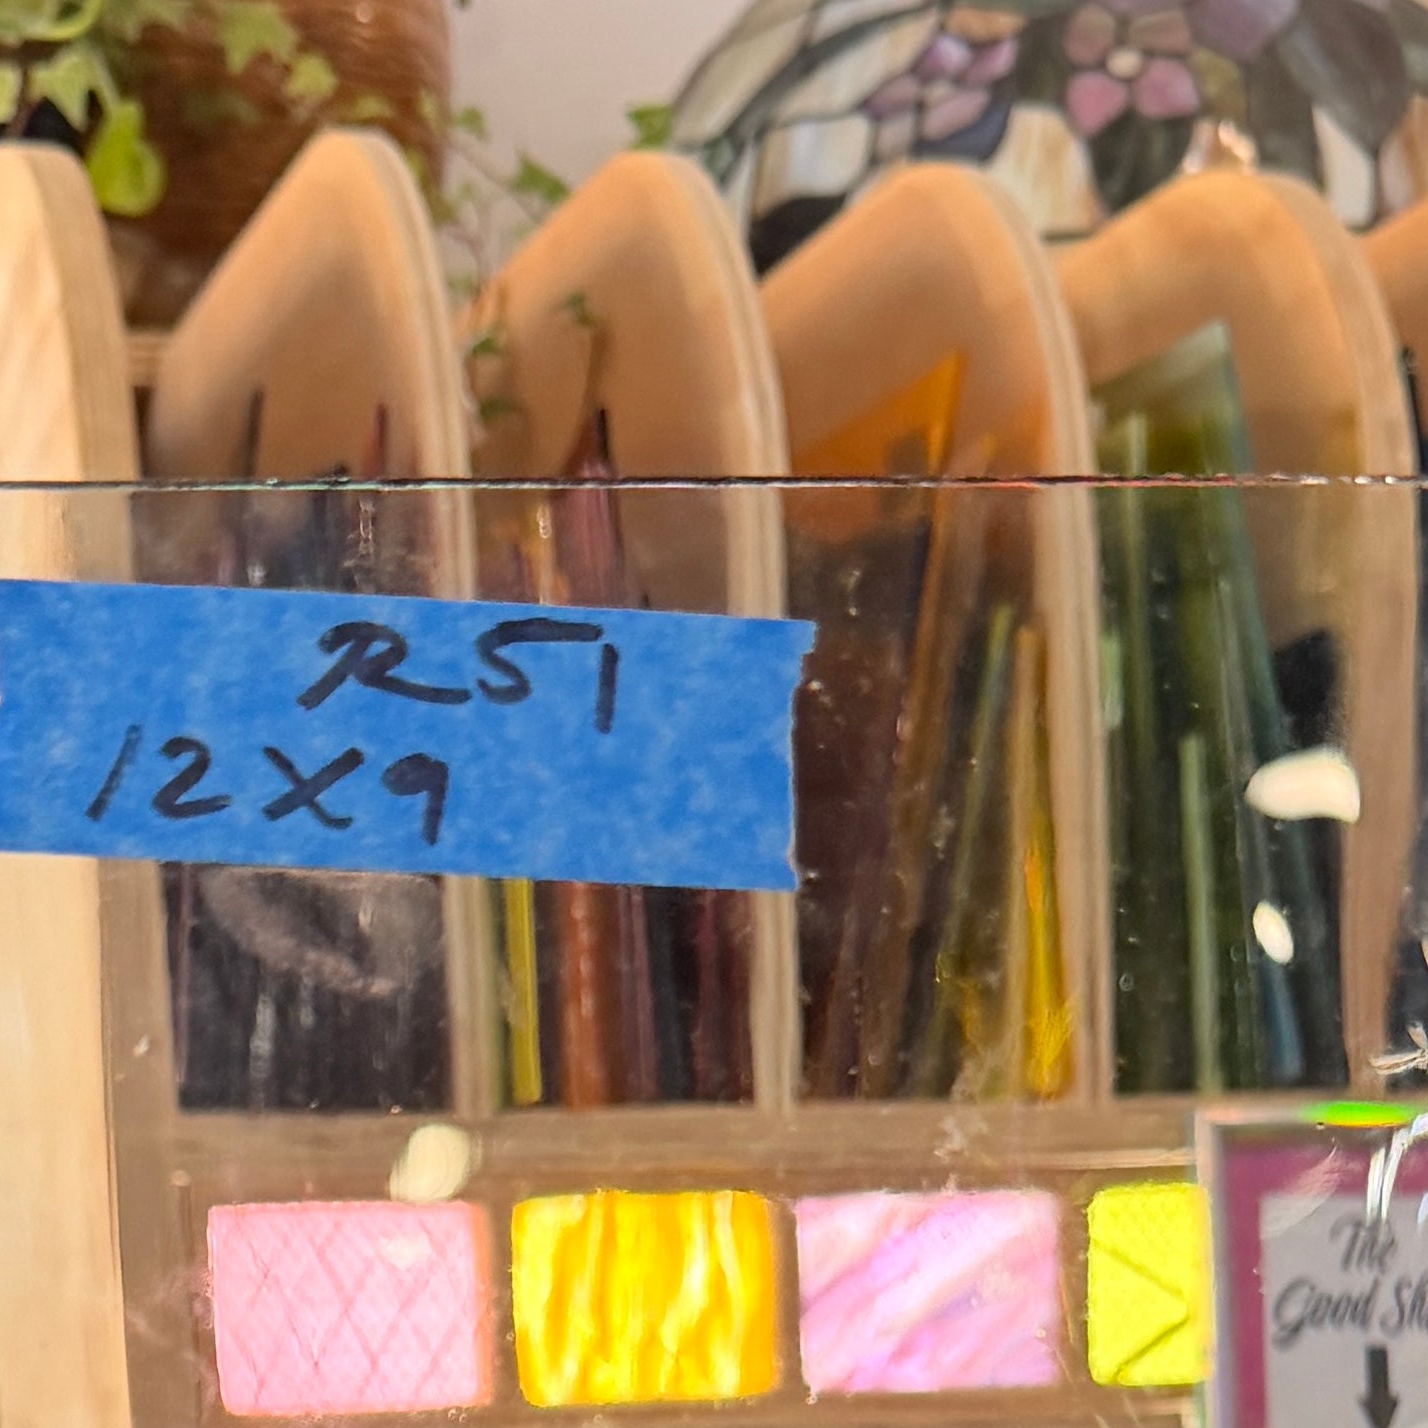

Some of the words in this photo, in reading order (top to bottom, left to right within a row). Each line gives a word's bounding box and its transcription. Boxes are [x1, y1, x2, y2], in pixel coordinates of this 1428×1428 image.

[295, 617, 619, 735] R51
[1329, 1212, 1399, 1275] The
[1272, 1274, 1379, 1351] Good
